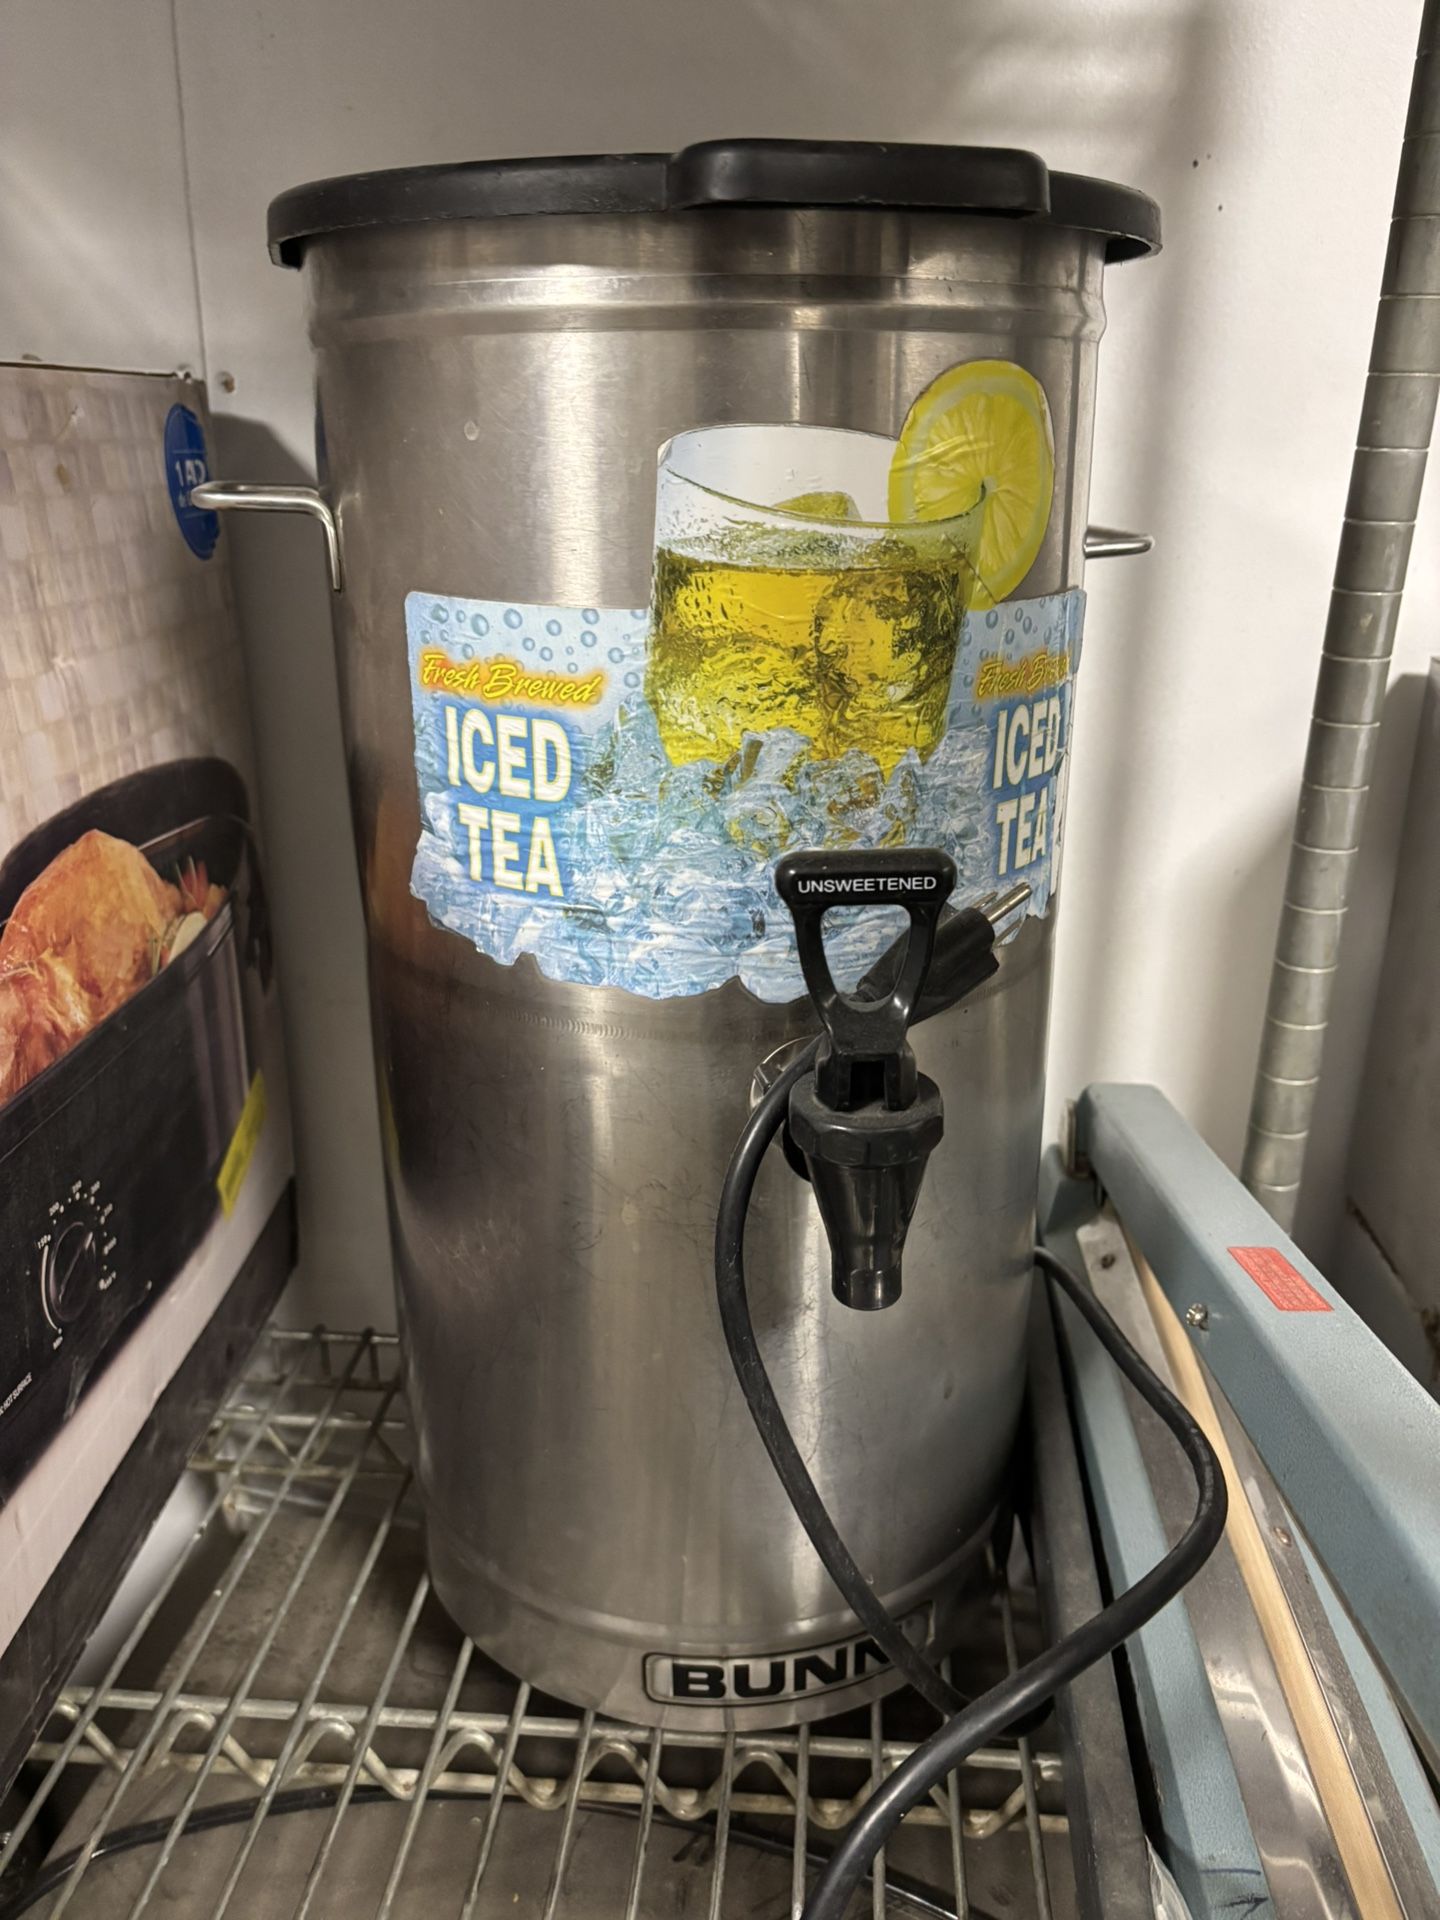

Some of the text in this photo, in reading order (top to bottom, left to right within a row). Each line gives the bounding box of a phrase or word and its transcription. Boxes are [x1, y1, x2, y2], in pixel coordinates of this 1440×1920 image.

[422, 653, 602, 702] Fresh Brewed
[444, 705, 572, 803] ICED
[992, 696, 1061, 790] ICED
[457, 802, 564, 898] TEA
[996, 787, 1048, 876] TEA
[797, 876, 937, 894] UNSWEETENED
